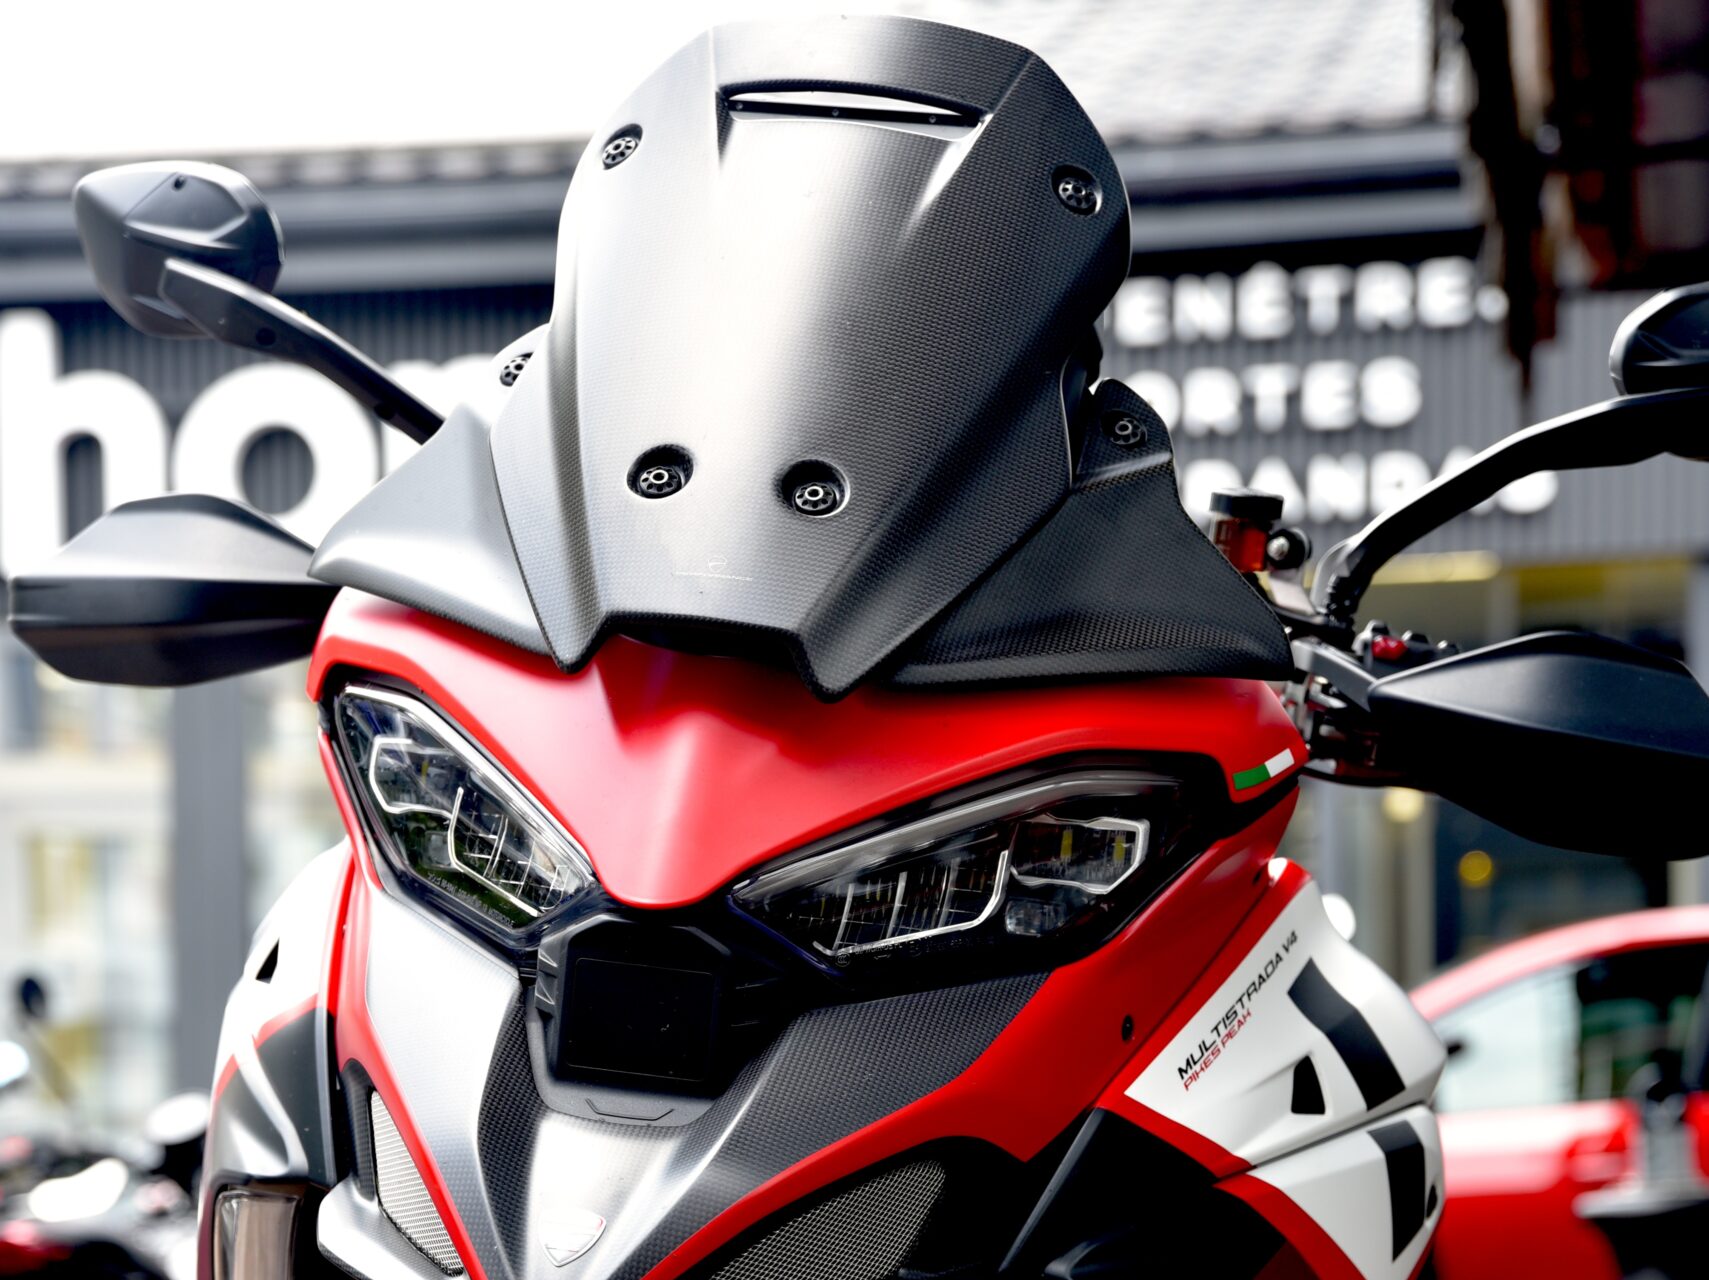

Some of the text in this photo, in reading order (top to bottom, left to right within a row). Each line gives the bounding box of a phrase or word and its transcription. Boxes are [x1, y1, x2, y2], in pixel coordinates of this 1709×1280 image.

[1122, 355, 1422, 437] ORTES
[1177, 930, 1299, 1081] MULTISTRADA V4
[1183, 1009, 1253, 1092] PIKES PEAK
